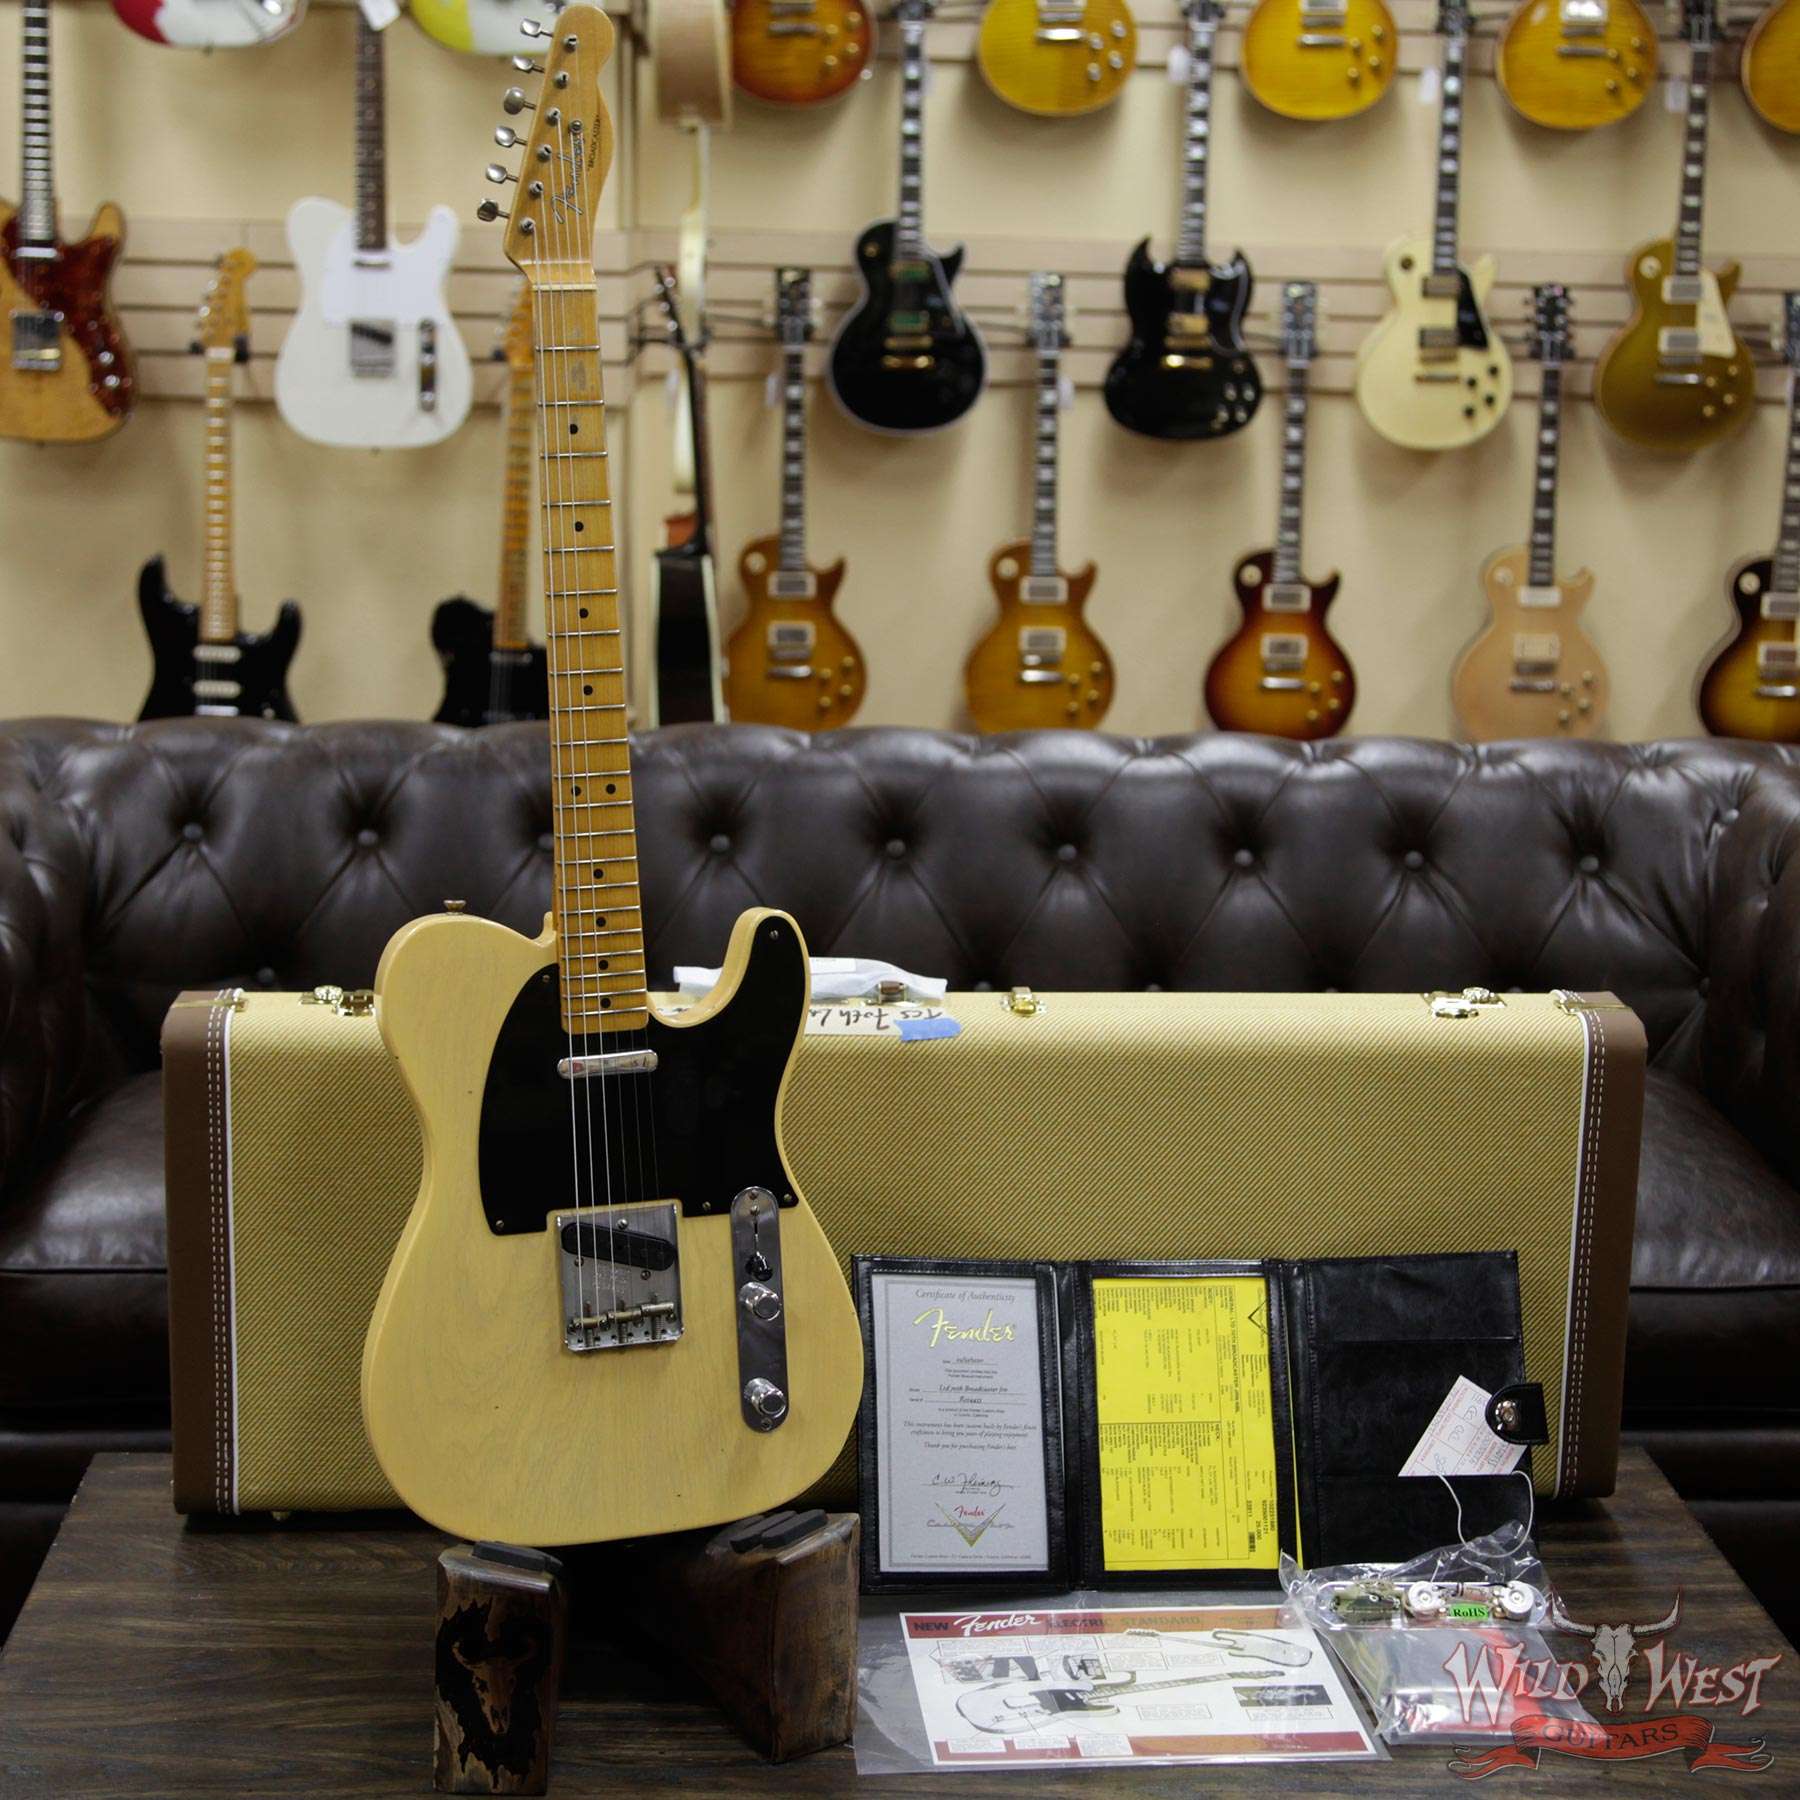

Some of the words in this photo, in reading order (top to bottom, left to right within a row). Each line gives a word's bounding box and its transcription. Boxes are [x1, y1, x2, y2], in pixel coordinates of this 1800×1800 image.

[958, 1290, 966, 1303] of
[912, 1307, 1015, 1348] Fender
[1453, 1607, 1486, 1617] RoHS
[913, 1622, 950, 1631] NEW
[953, 1613, 1041, 1636] Fender
